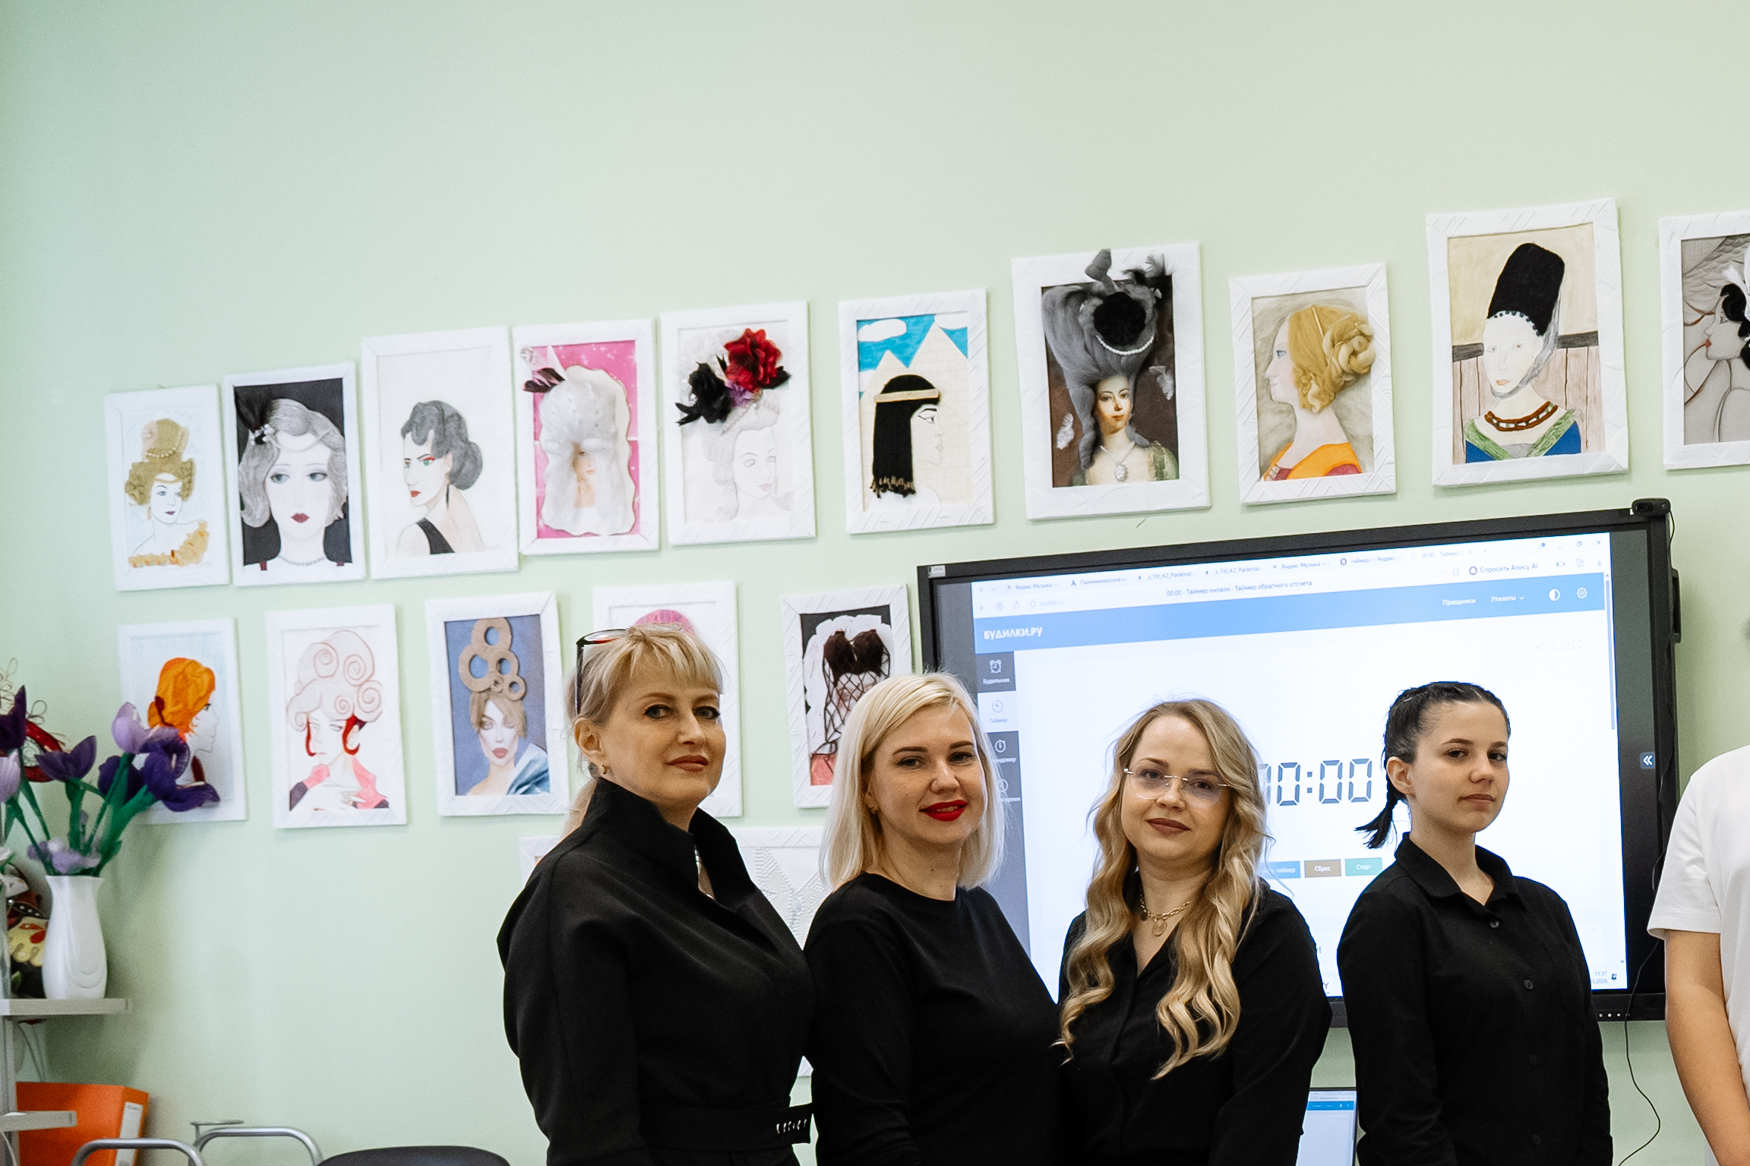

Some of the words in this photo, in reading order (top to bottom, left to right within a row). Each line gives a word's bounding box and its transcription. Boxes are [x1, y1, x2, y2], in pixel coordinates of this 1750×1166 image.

[1480, 565, 1510, 574] Спросить
[1511, 564, 1530, 573] Алису
[1186, 587, 1208, 596] Таймер
[1209, 585, 1231, 594] онлайн
[1235, 583, 1257, 592] Таймер
[1258, 581, 1289, 591] обратного
[983, 627, 1043, 640] БУДИЛКИ.РУ
